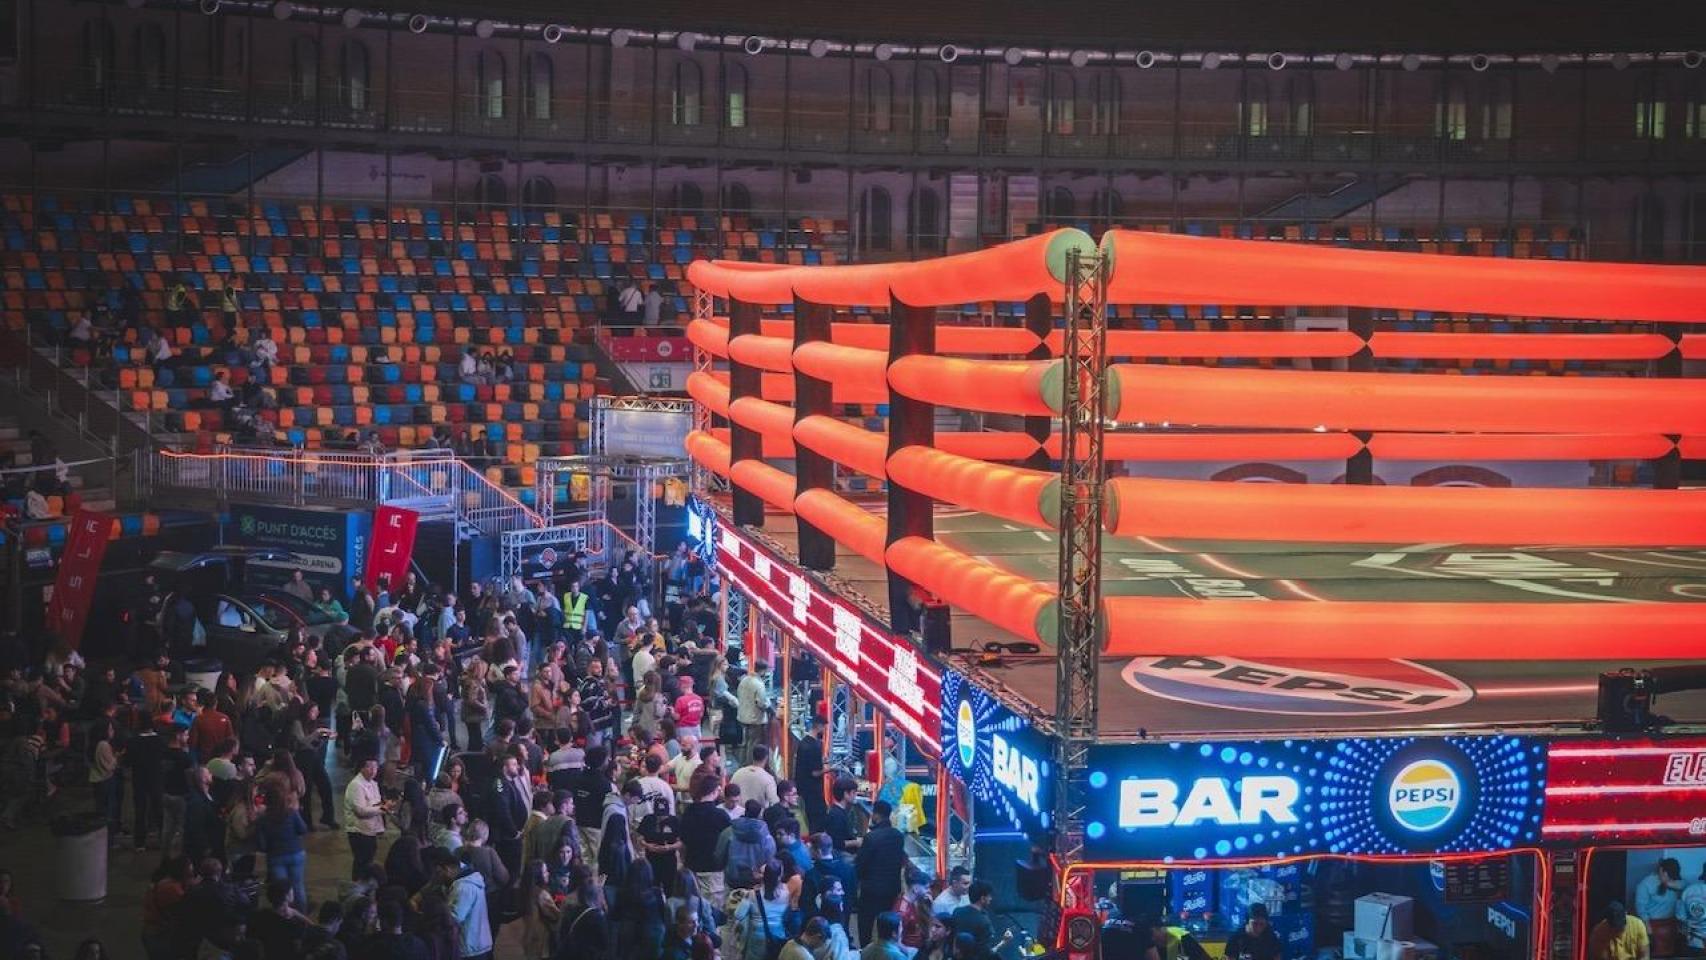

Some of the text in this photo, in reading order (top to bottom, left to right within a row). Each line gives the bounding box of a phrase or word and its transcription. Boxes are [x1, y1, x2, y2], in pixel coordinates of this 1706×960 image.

[257, 521, 288, 534] PUNT
[1148, 656, 1448, 706] PEPSI
[992, 734, 1039, 812] BAR
[1119, 774, 1300, 827] BAR
[1395, 788, 1456, 804] PEPSI
[1487, 907, 1515, 938] PEPSI
